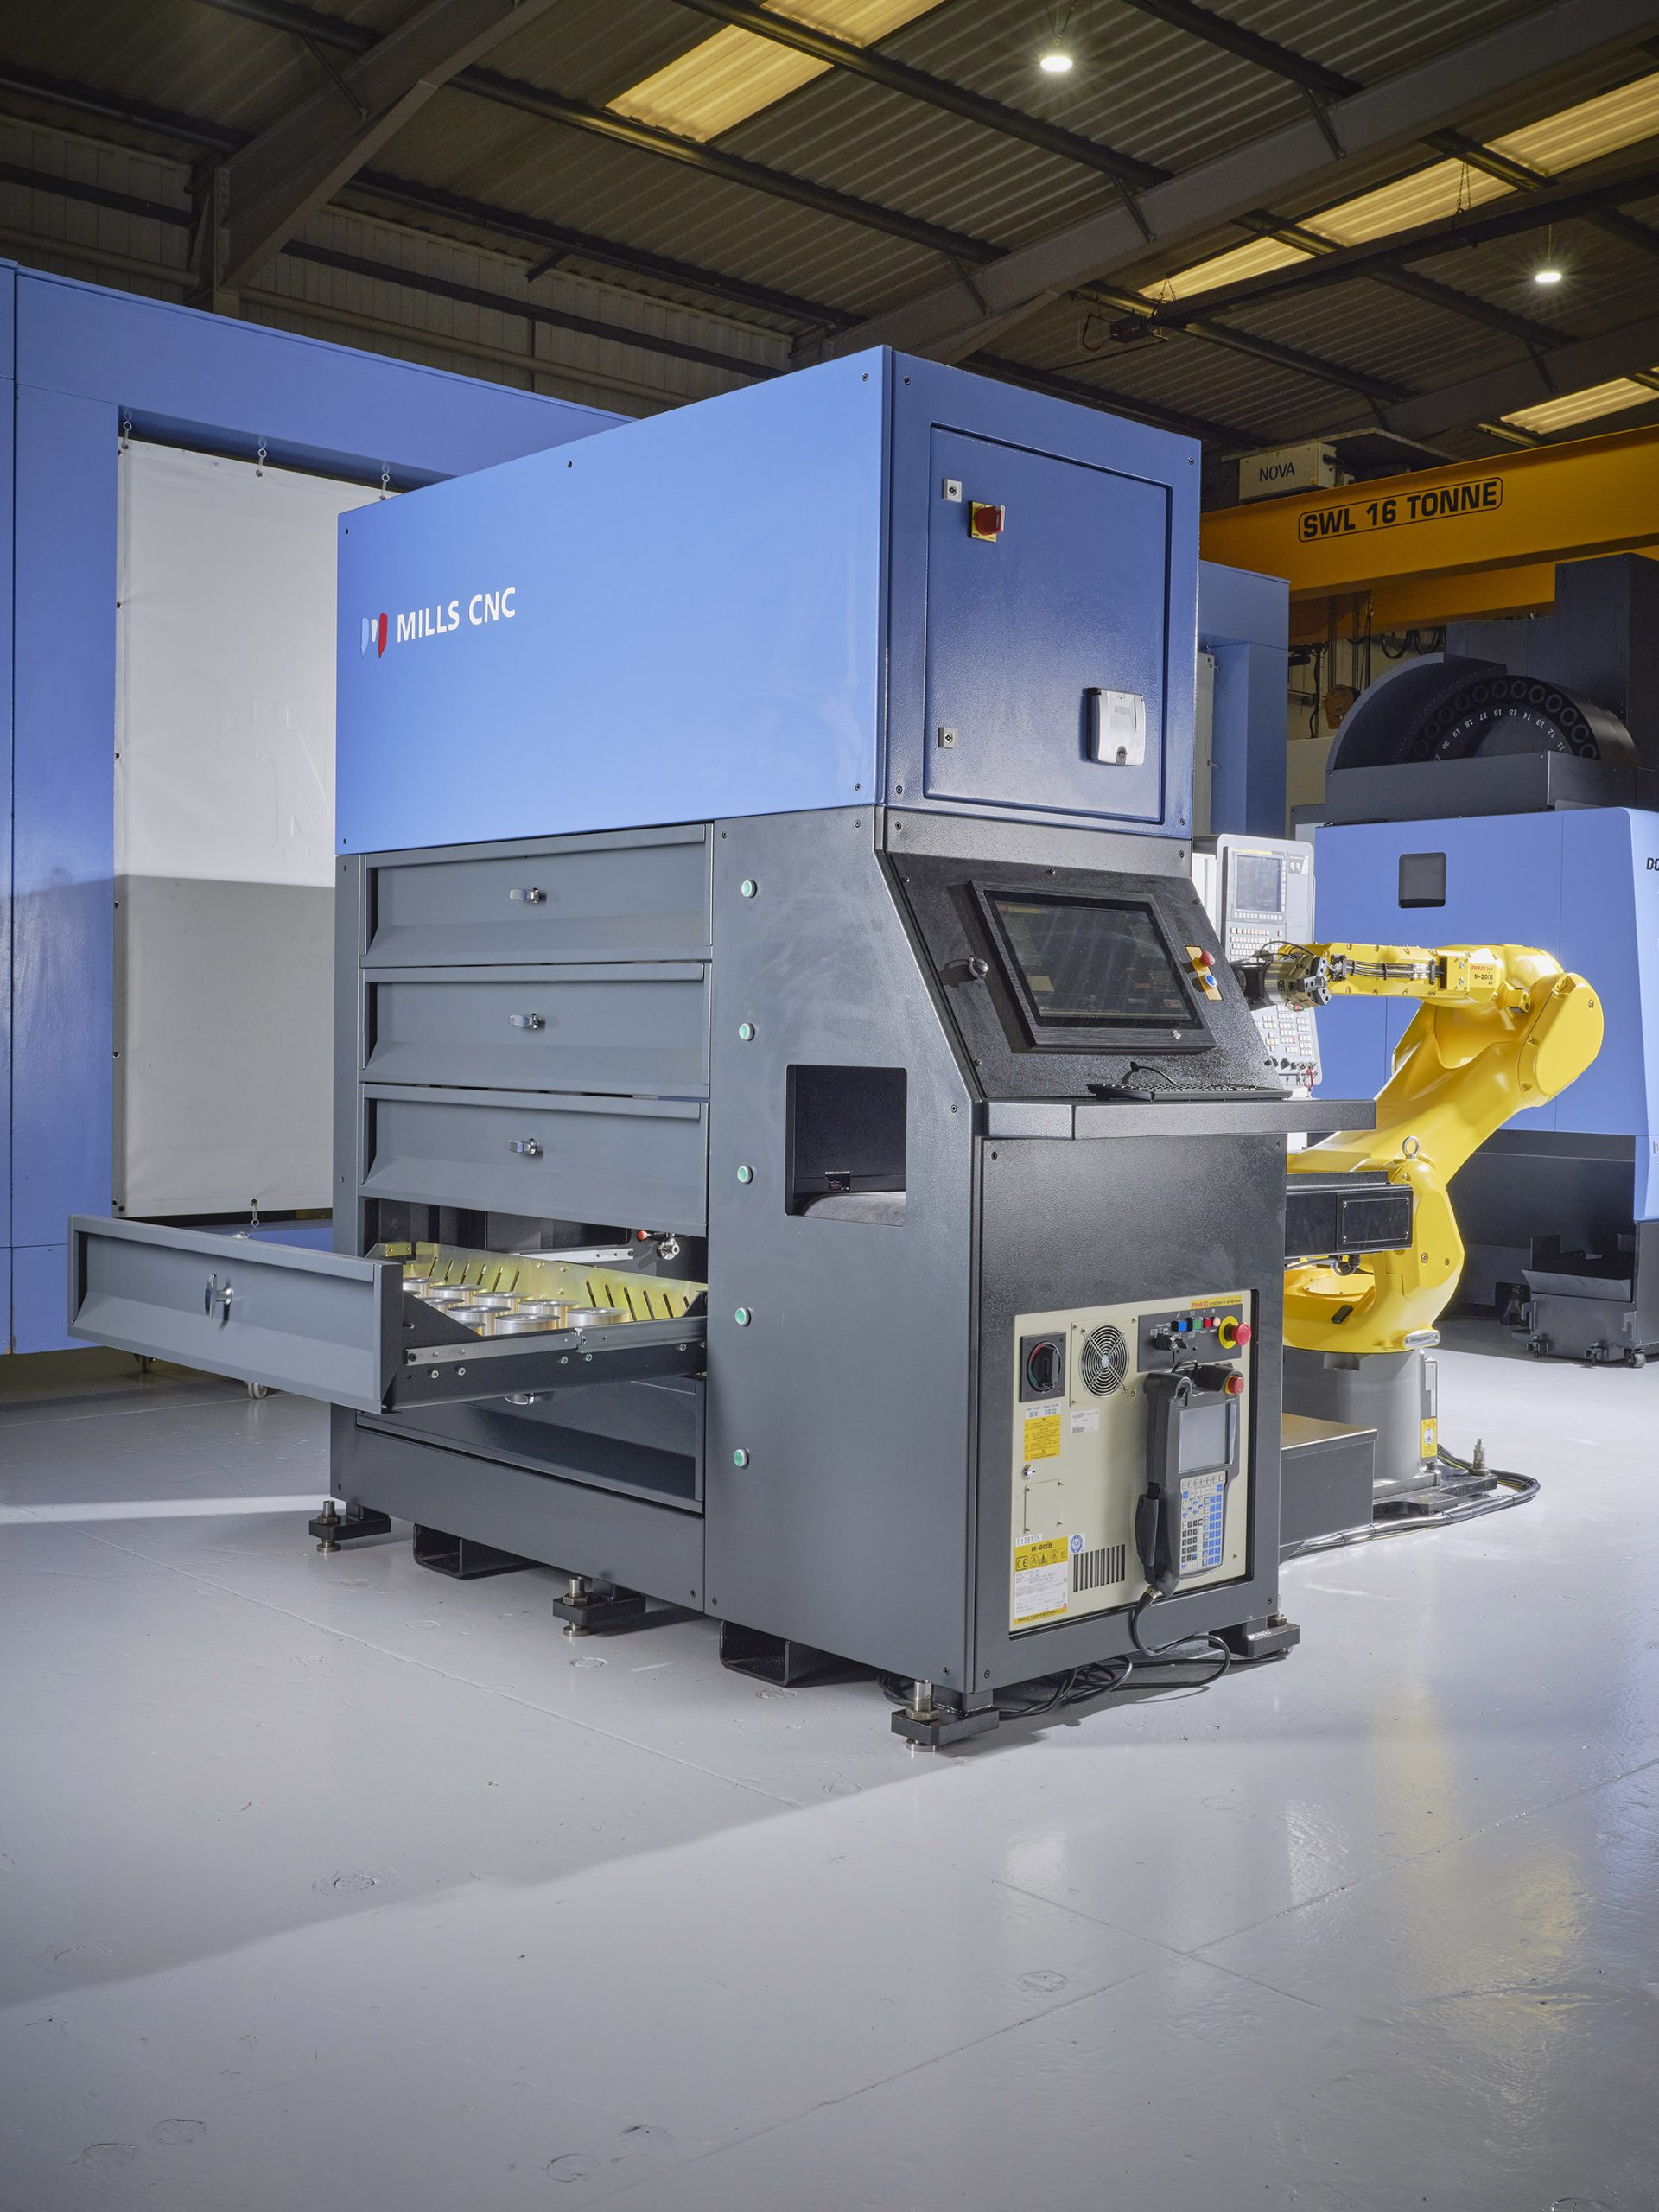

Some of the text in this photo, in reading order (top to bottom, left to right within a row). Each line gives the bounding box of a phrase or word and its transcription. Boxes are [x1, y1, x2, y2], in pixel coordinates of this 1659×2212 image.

[1259, 461, 1295, 482] NOVA
[1303, 481, 1497, 538] SWL 16 TONNE
[397, 586, 516, 643] MILLS CNC
[1479, 711, 1488, 721] 17
[1493, 709, 1502, 717] 16
[1509, 709, 1517, 717] 15
[1523, 712, 1532, 721] 14
[1535, 718, 1545, 728] 13
[1547, 728, 1556, 739] 12
[1441, 740, 1451, 750] 20
[1557, 741, 1566, 752] 11
